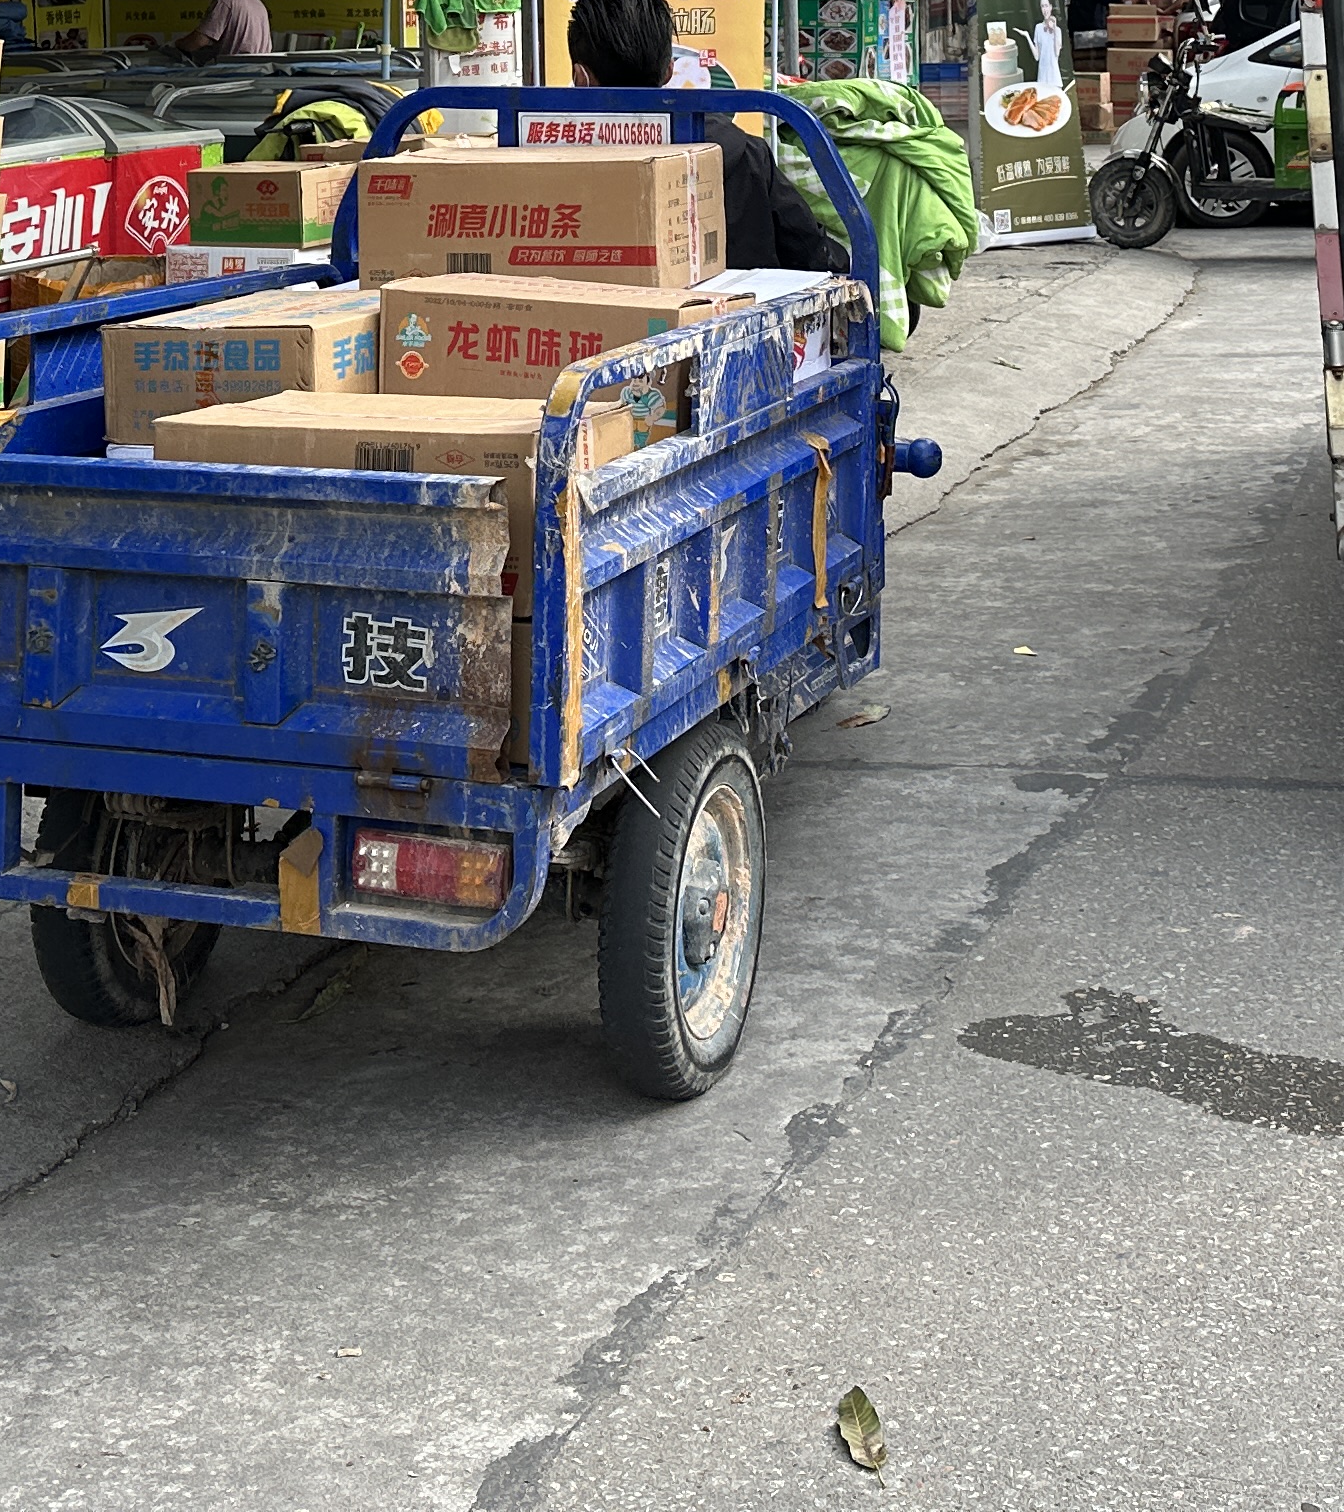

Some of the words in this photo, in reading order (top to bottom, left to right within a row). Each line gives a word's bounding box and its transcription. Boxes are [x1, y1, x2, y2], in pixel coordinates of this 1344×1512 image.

[490, 61, 509, 74] 电话
[526, 122, 596, 145] 服务电话
[597, 122, 663, 146] 4001068608
[138, 194, 181, 238] 安井
[426, 203, 583, 240] 涮煮小油条
[332, 329, 376, 381] 手恭
[447, 319, 604, 368] 龙虾味球
[341, 611, 434, 692] 技
